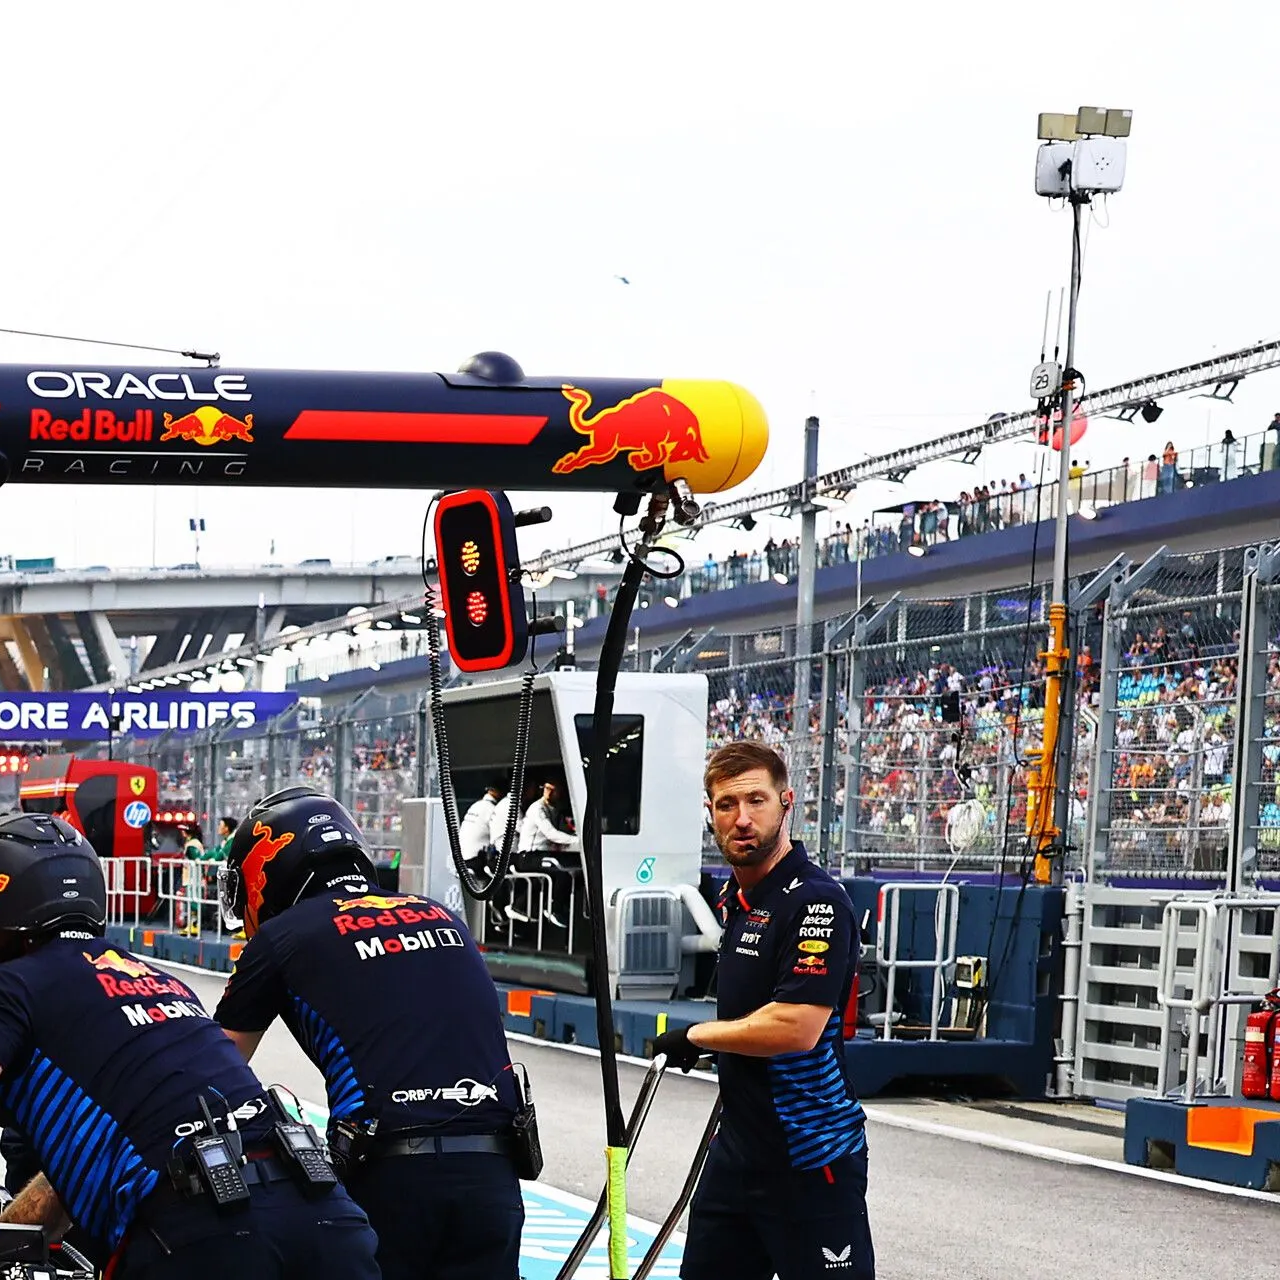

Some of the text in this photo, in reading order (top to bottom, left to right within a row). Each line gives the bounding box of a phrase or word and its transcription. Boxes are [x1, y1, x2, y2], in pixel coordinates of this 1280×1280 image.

[27, 371, 252, 401] ORACLE
[30, 408, 153, 442] Red Bull
[22, 458, 246, 475] RACING
[127, 807, 148, 824] hp
[327, 874, 366, 888] HONDA
[807, 904, 834, 914] VISA
[332, 905, 453, 935] Red Bull
[799, 927, 834, 938] ROKT
[354, 930, 436, 960] Mobil
[121, 1001, 192, 1027] Mobil
